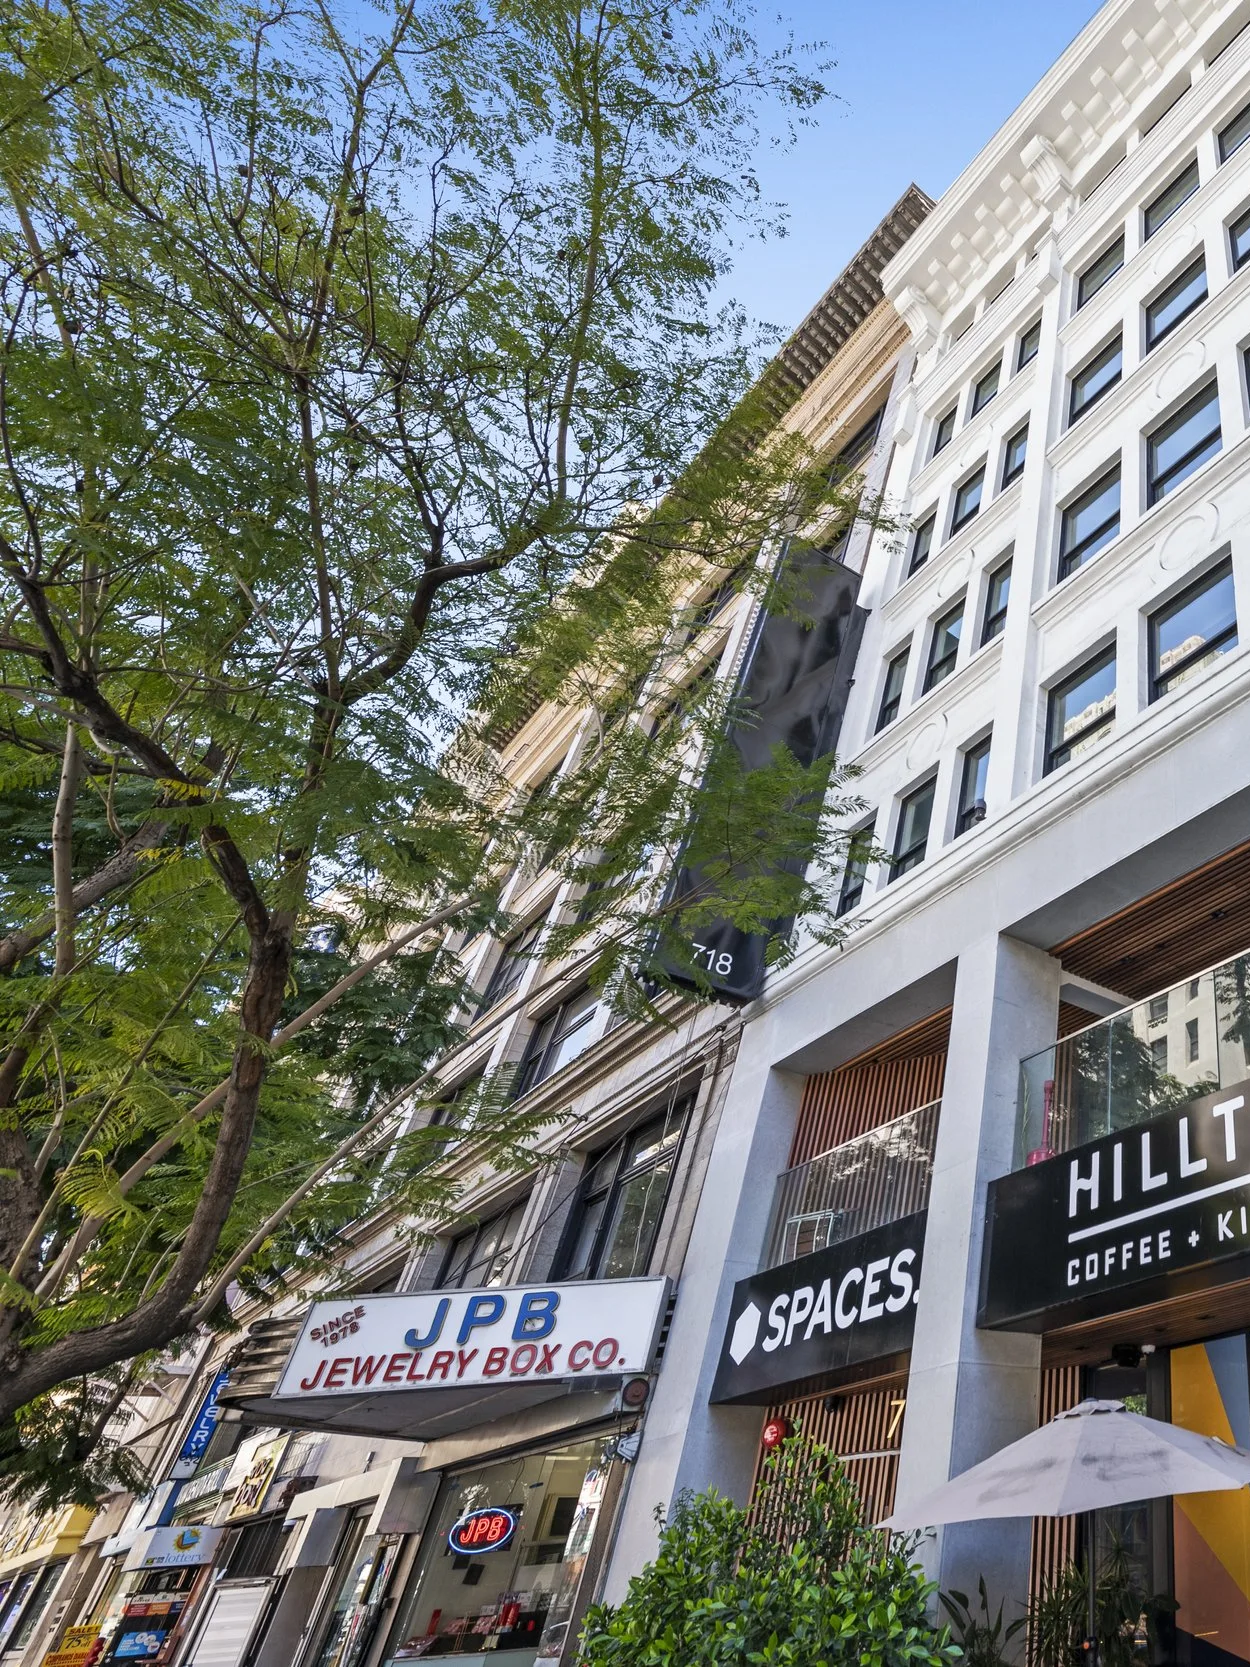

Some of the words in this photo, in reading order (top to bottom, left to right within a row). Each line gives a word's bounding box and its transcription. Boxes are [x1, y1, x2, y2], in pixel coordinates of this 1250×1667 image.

[690, 942, 733, 975] 718
[1067, 1229, 1171, 1287] COFFEE
[1188, 1230, 1200, 1248] +
[762, 1248, 920, 1353] SPACES.
[310, 1305, 366, 1341] SINCE
[320, 1322, 360, 1348] 1978
[404, 1290, 561, 1350] JPB
[300, 1348, 479, 1391] JEWELRY
[482, 1343, 561, 1376] BOX
[568, 1338, 626, 1371] CO.
[886, 1400, 906, 1440] 7
[459, 1516, 504, 1544] JPB
[164, 1553, 204, 1563] lottery
